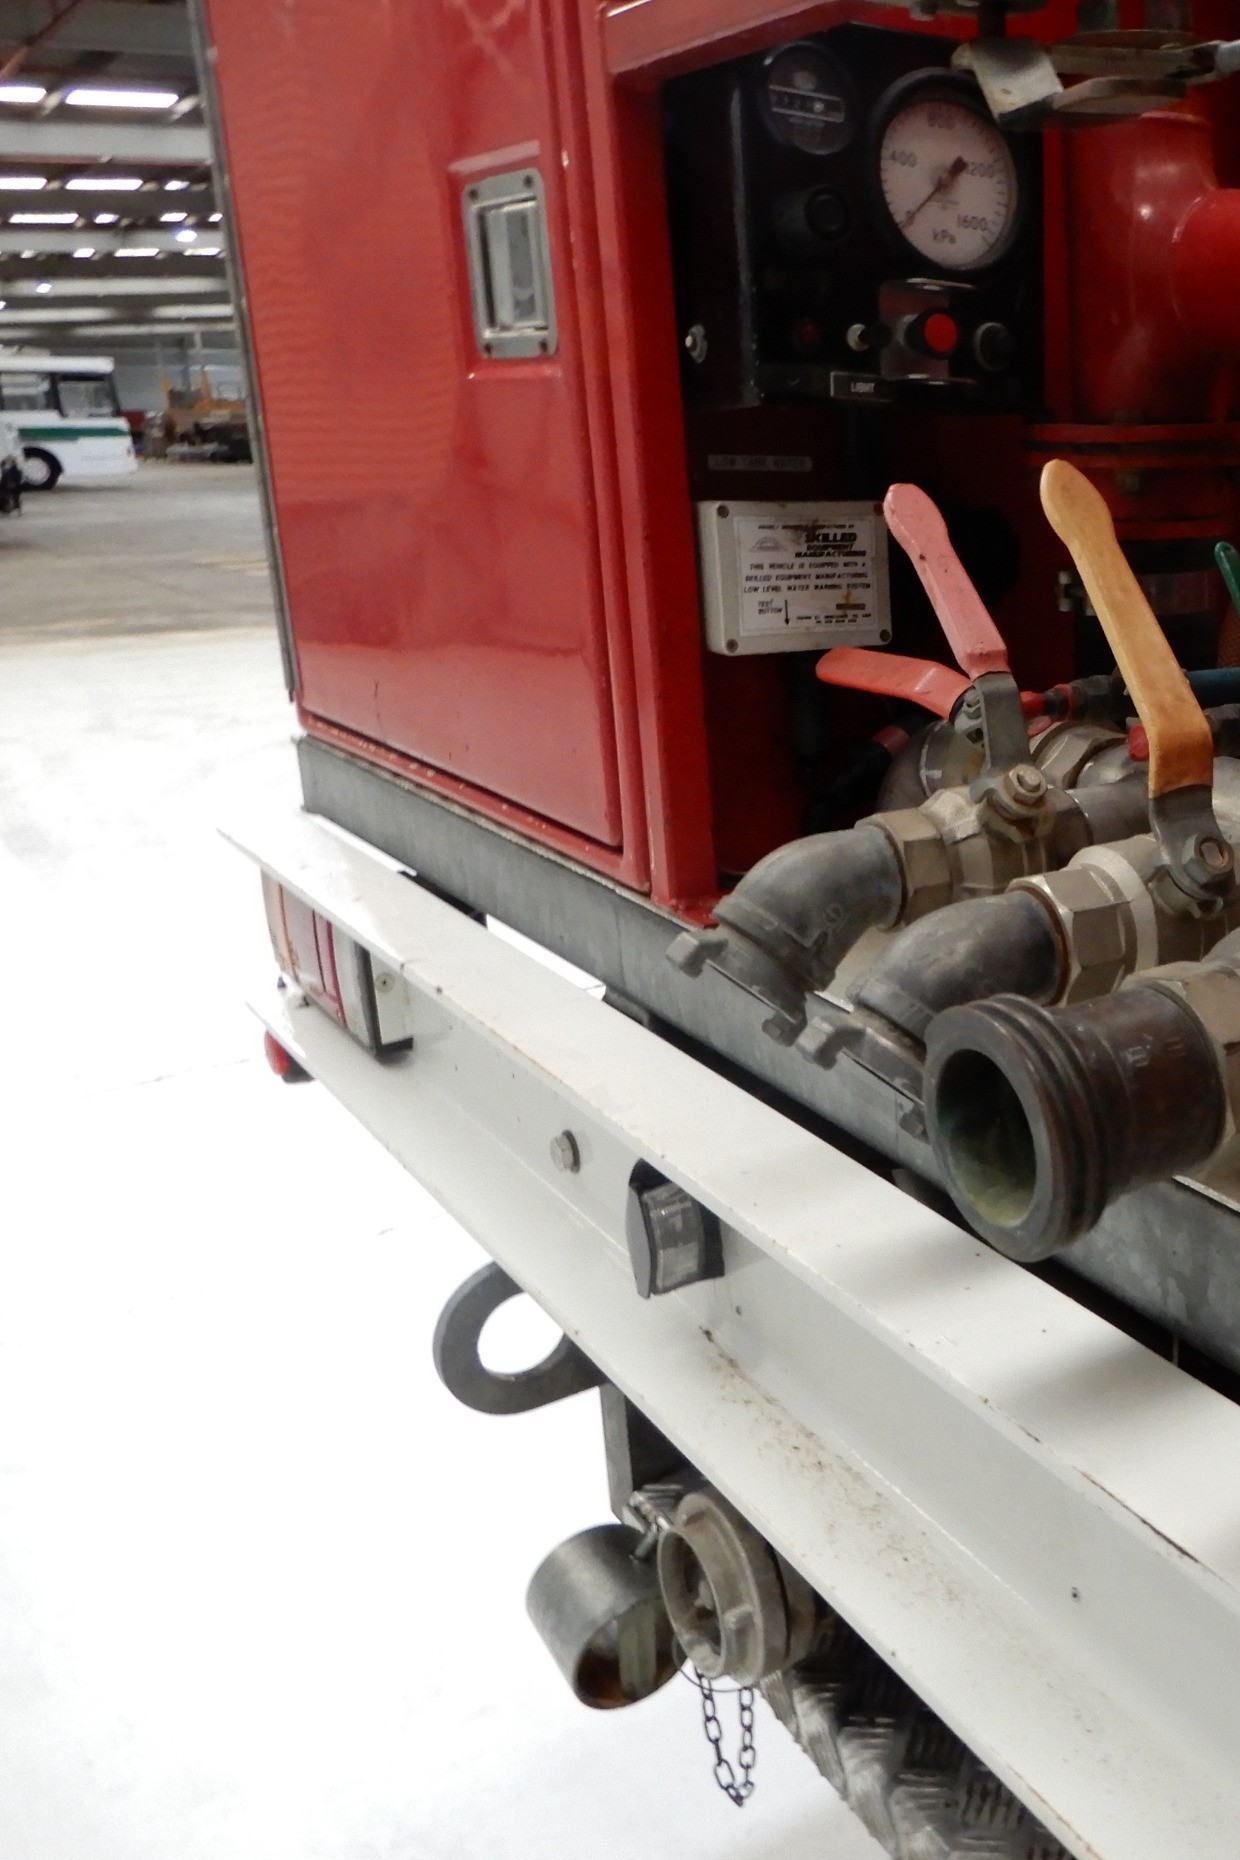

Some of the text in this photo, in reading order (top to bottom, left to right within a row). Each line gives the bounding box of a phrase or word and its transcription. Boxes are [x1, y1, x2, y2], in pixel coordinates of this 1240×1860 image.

[890, 150, 918, 168] 400
[957, 214, 988, 231] 1600
[805, 533, 857, 543] SKILLED
[807, 543, 854, 551] EQUIPMENT
[769, 562, 794, 570] VEHICLE
[815, 572, 868, 580] MANUFACTURING
[763, 585, 782, 593] LEVEL
[787, 584, 810, 592] WATER
[814, 583, 842, 591] WARNING
